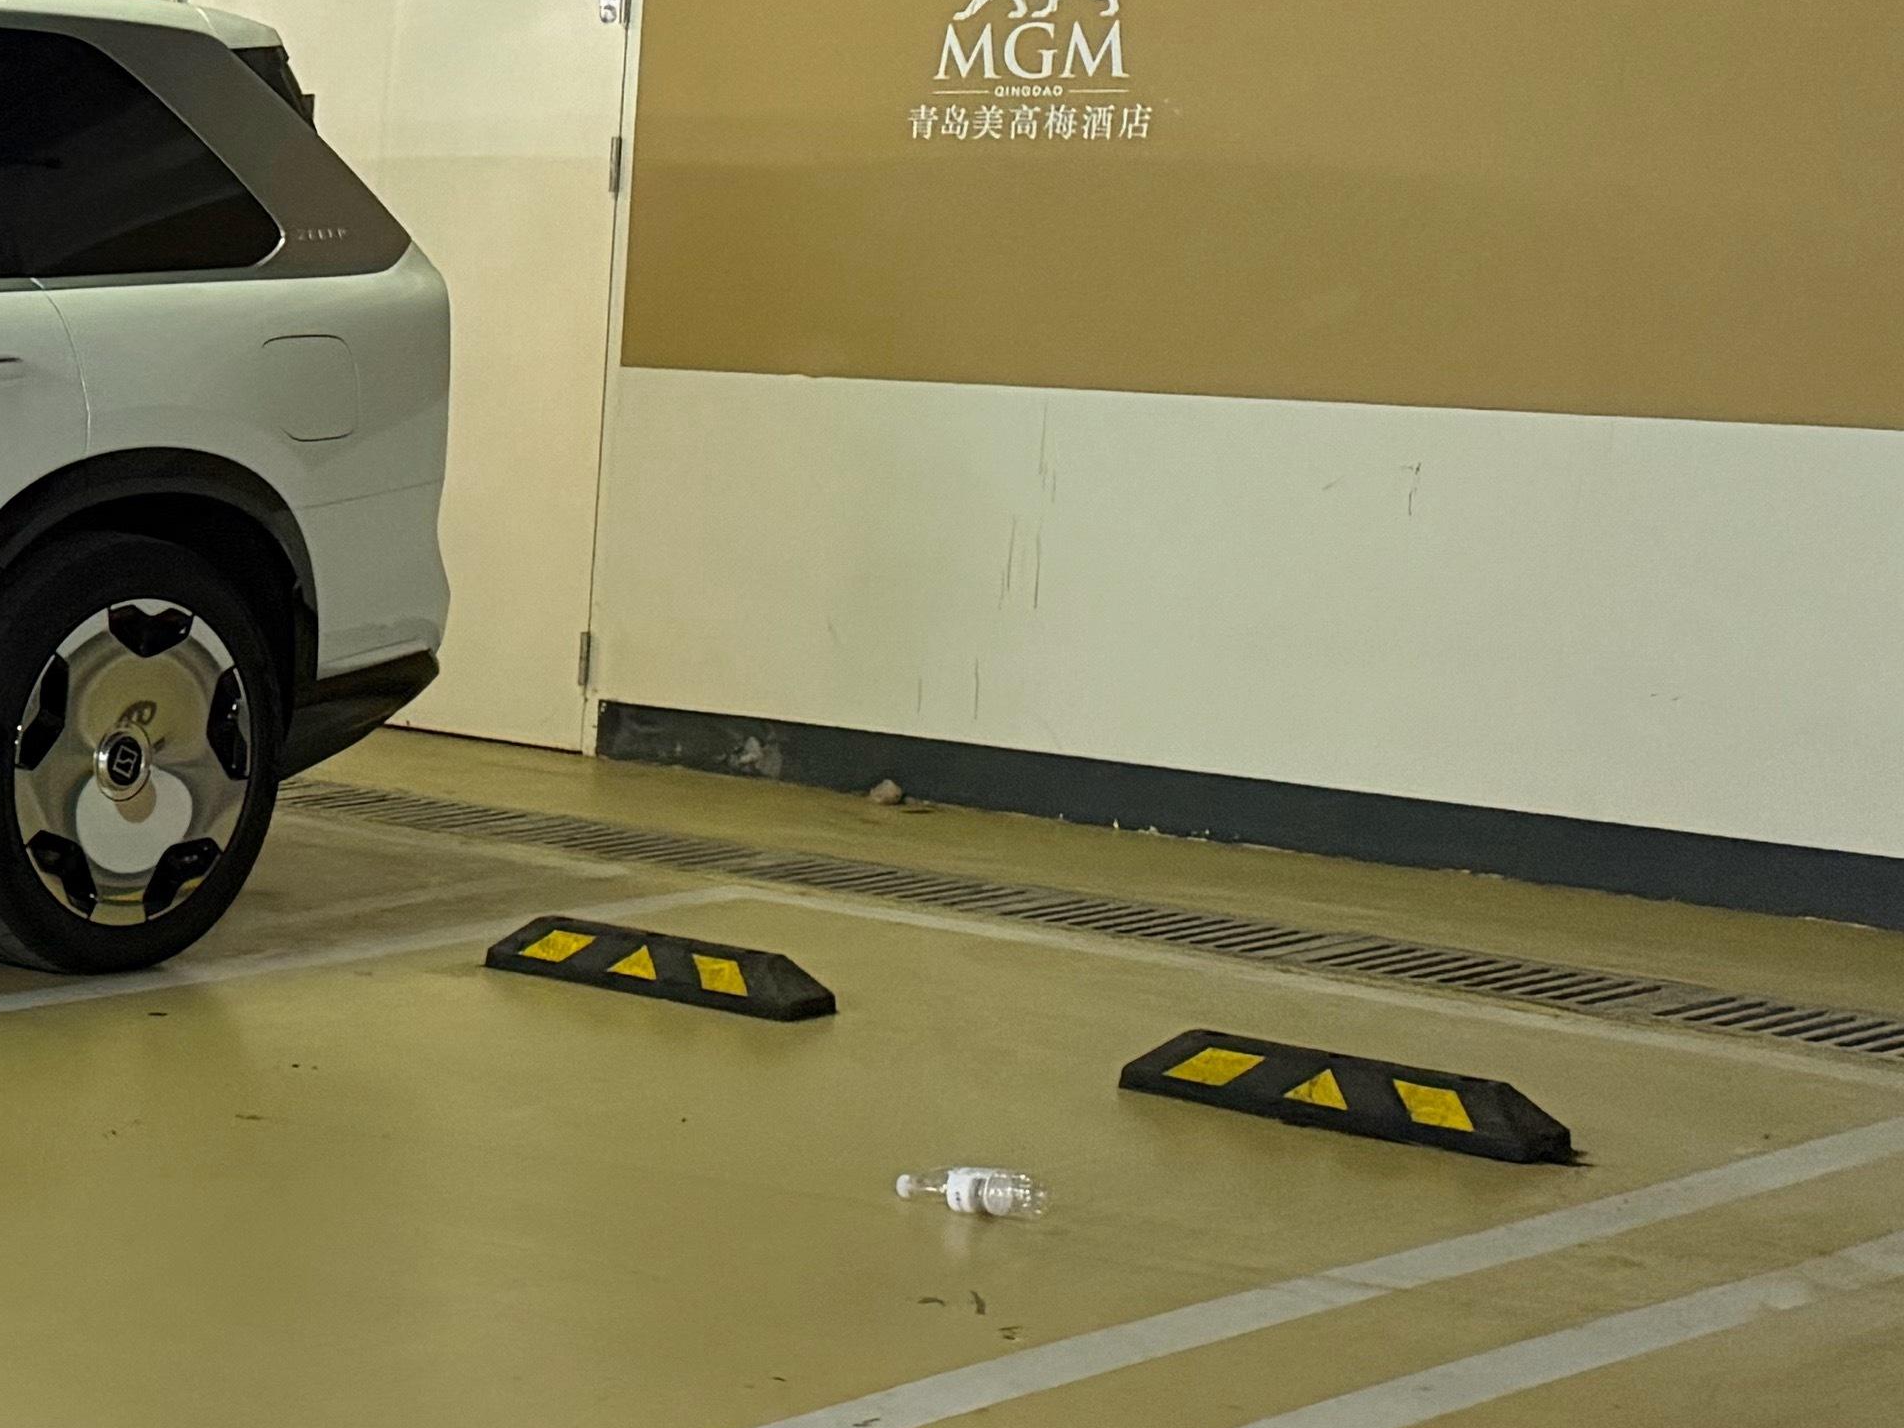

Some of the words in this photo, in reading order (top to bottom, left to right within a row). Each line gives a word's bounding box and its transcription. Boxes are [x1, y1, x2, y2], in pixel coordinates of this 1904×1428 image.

[933, 20, 1130, 80] MGM
[994, 85, 1064, 98] QINGDAO
[907, 103, 1153, 141] 青岛美高梅酒店
